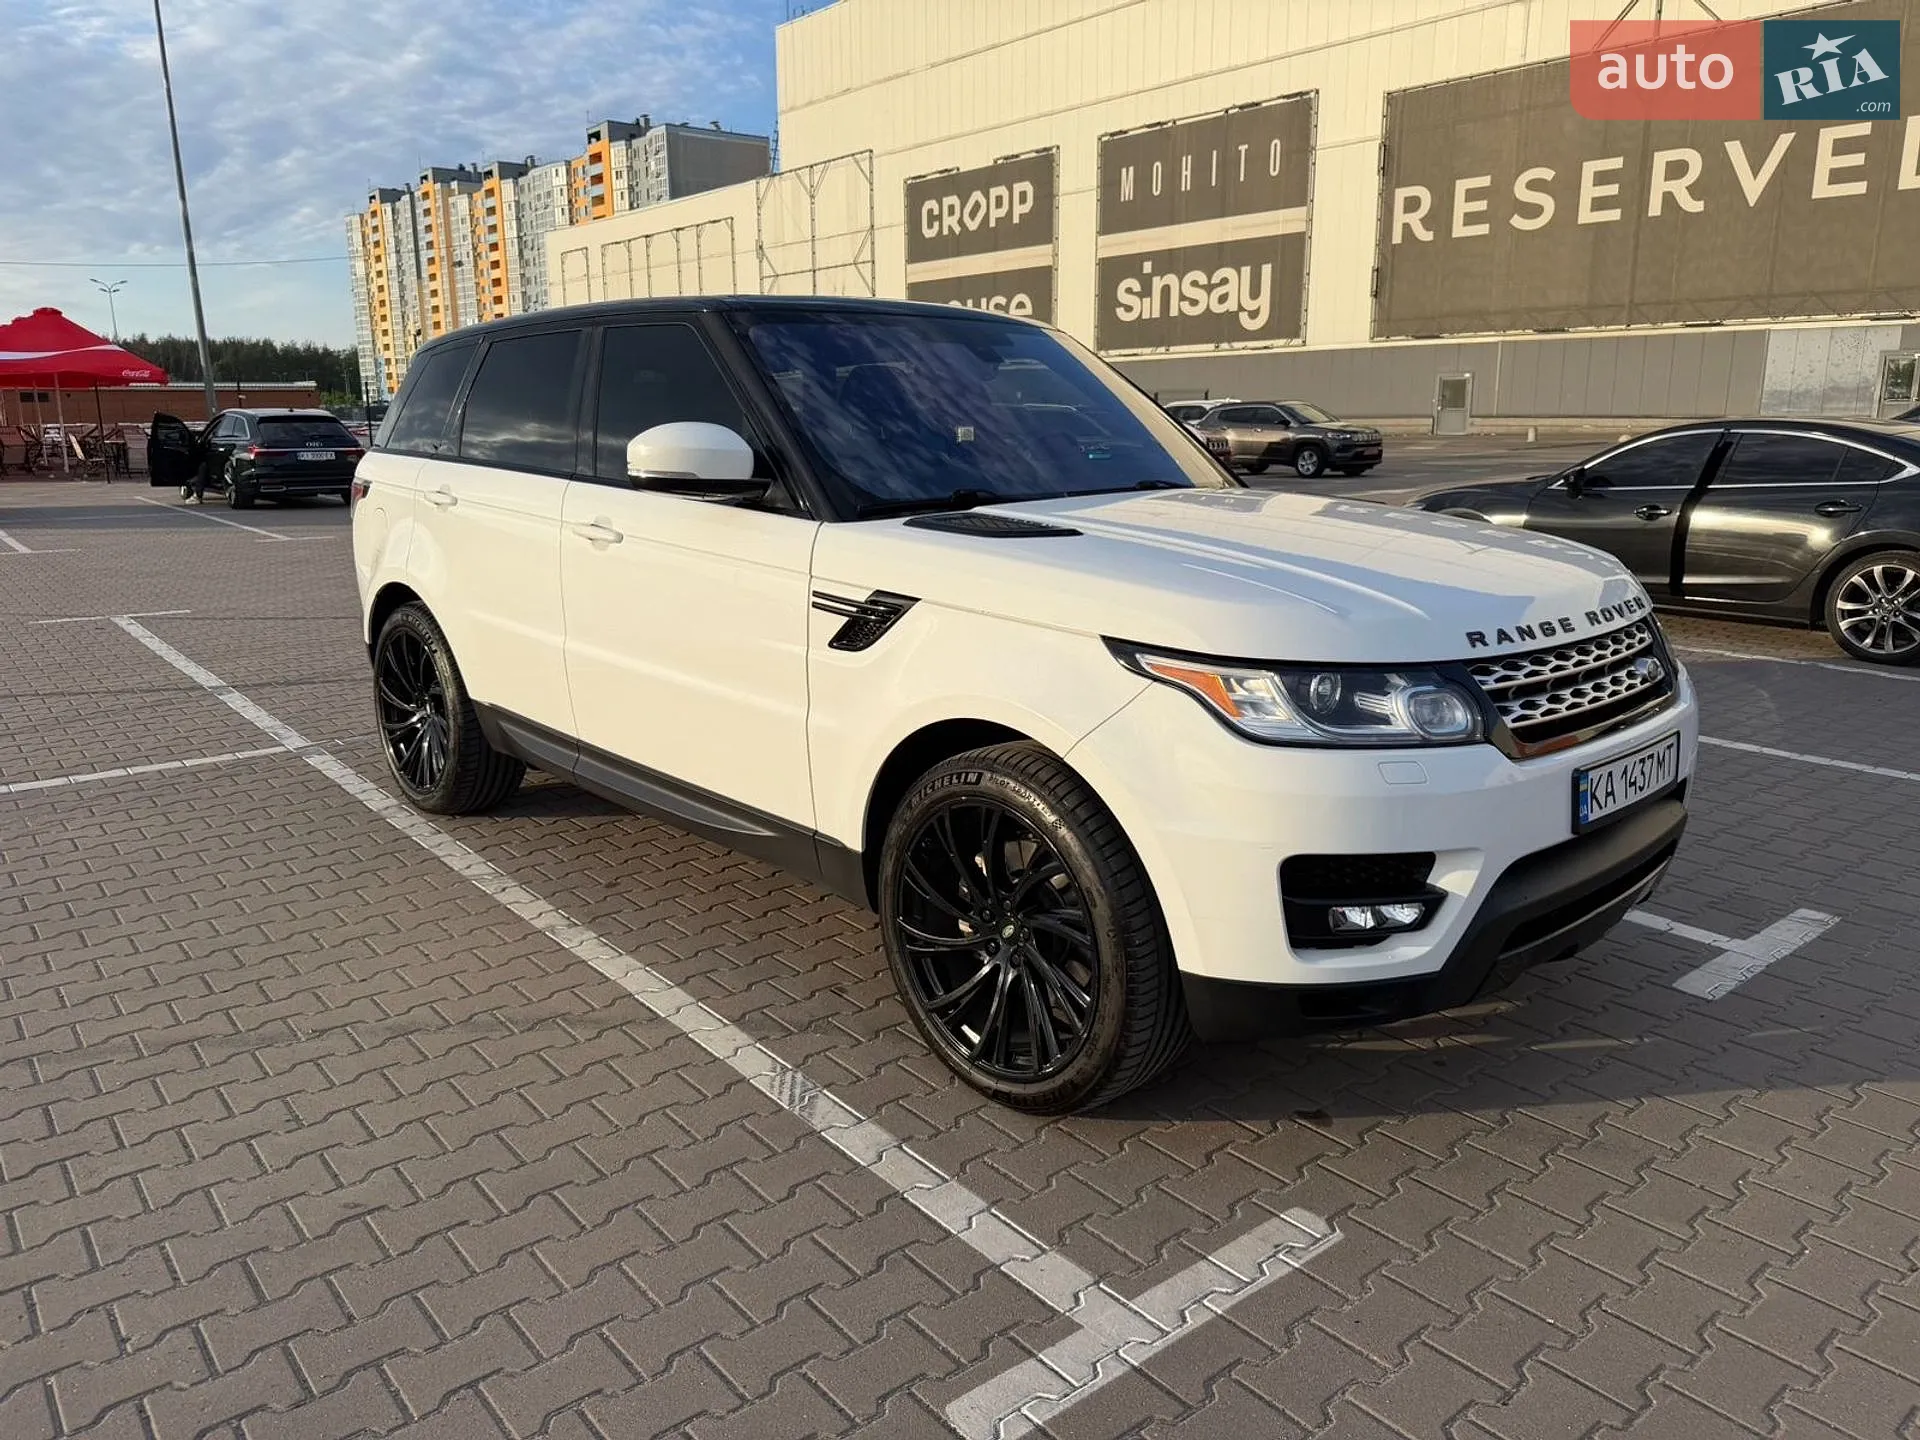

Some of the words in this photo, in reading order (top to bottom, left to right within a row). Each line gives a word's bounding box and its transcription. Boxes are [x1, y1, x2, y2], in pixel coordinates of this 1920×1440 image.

[1120, 138, 1282, 203] MOHITO
[921, 180, 1034, 239] CROPP
[1115, 261, 1273, 332] sinsay
[1465, 616, 1576, 648] RANGE
[1585, 595, 1646, 626] ROVER
[911, 771, 983, 807] MICHELIN
